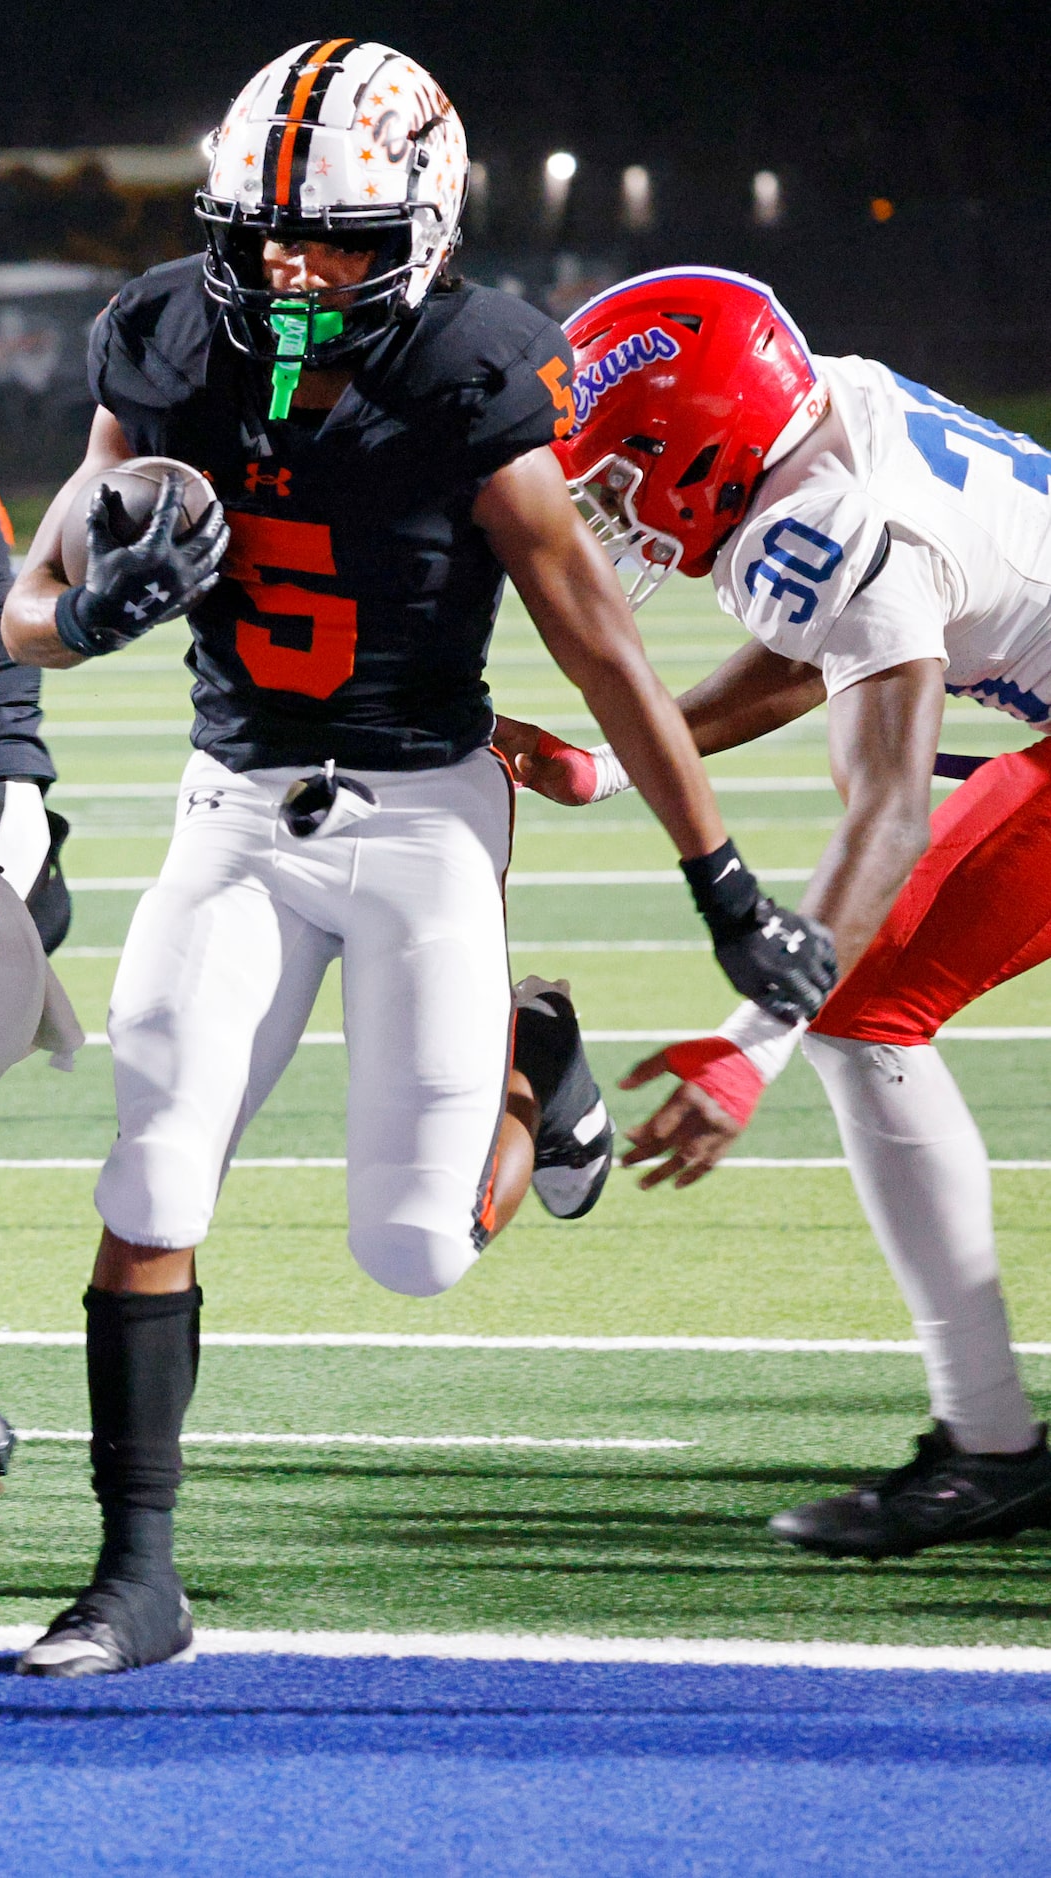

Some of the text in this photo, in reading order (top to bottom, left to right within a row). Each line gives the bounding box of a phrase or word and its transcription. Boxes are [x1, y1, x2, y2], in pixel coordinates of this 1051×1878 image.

[537, 356, 576, 438] 5
[569, 327, 680, 435] exans
[224, 511, 358, 700] 5
[745, 517, 844, 624] 30
